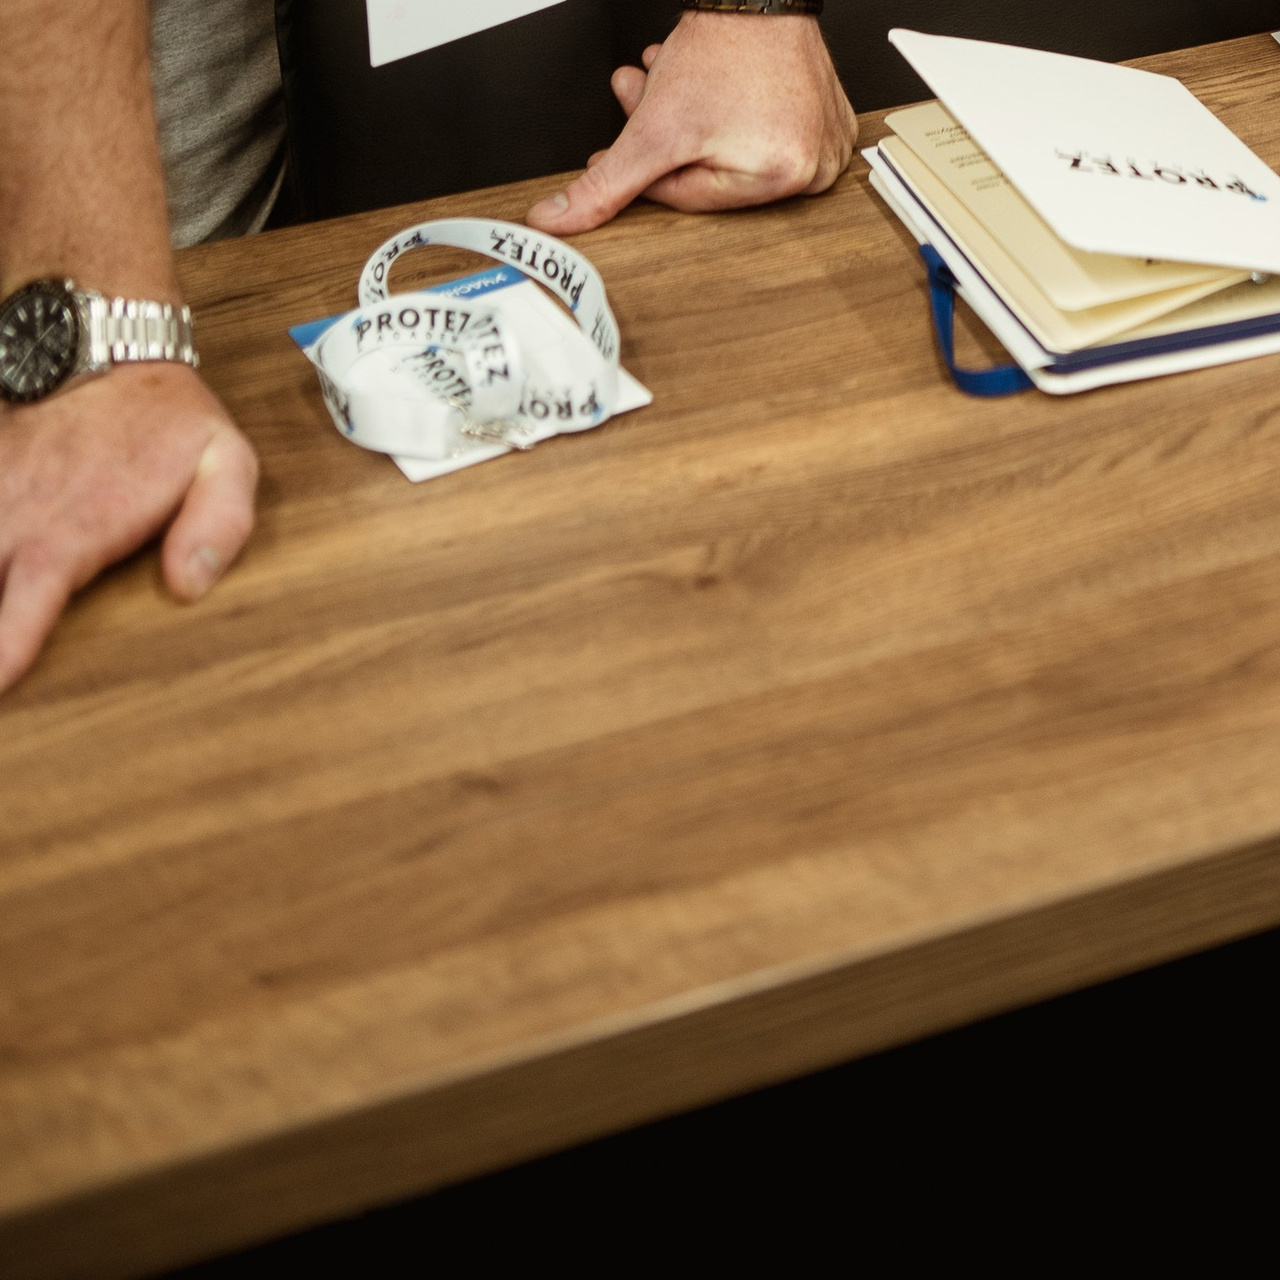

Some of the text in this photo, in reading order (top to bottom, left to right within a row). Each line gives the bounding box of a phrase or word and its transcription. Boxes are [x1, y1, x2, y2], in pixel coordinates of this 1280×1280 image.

[1057, 151, 1256, 197] PROTEZ
[490, 237, 587, 303] PROTEZ
[404, 349, 472, 402] PROTE
